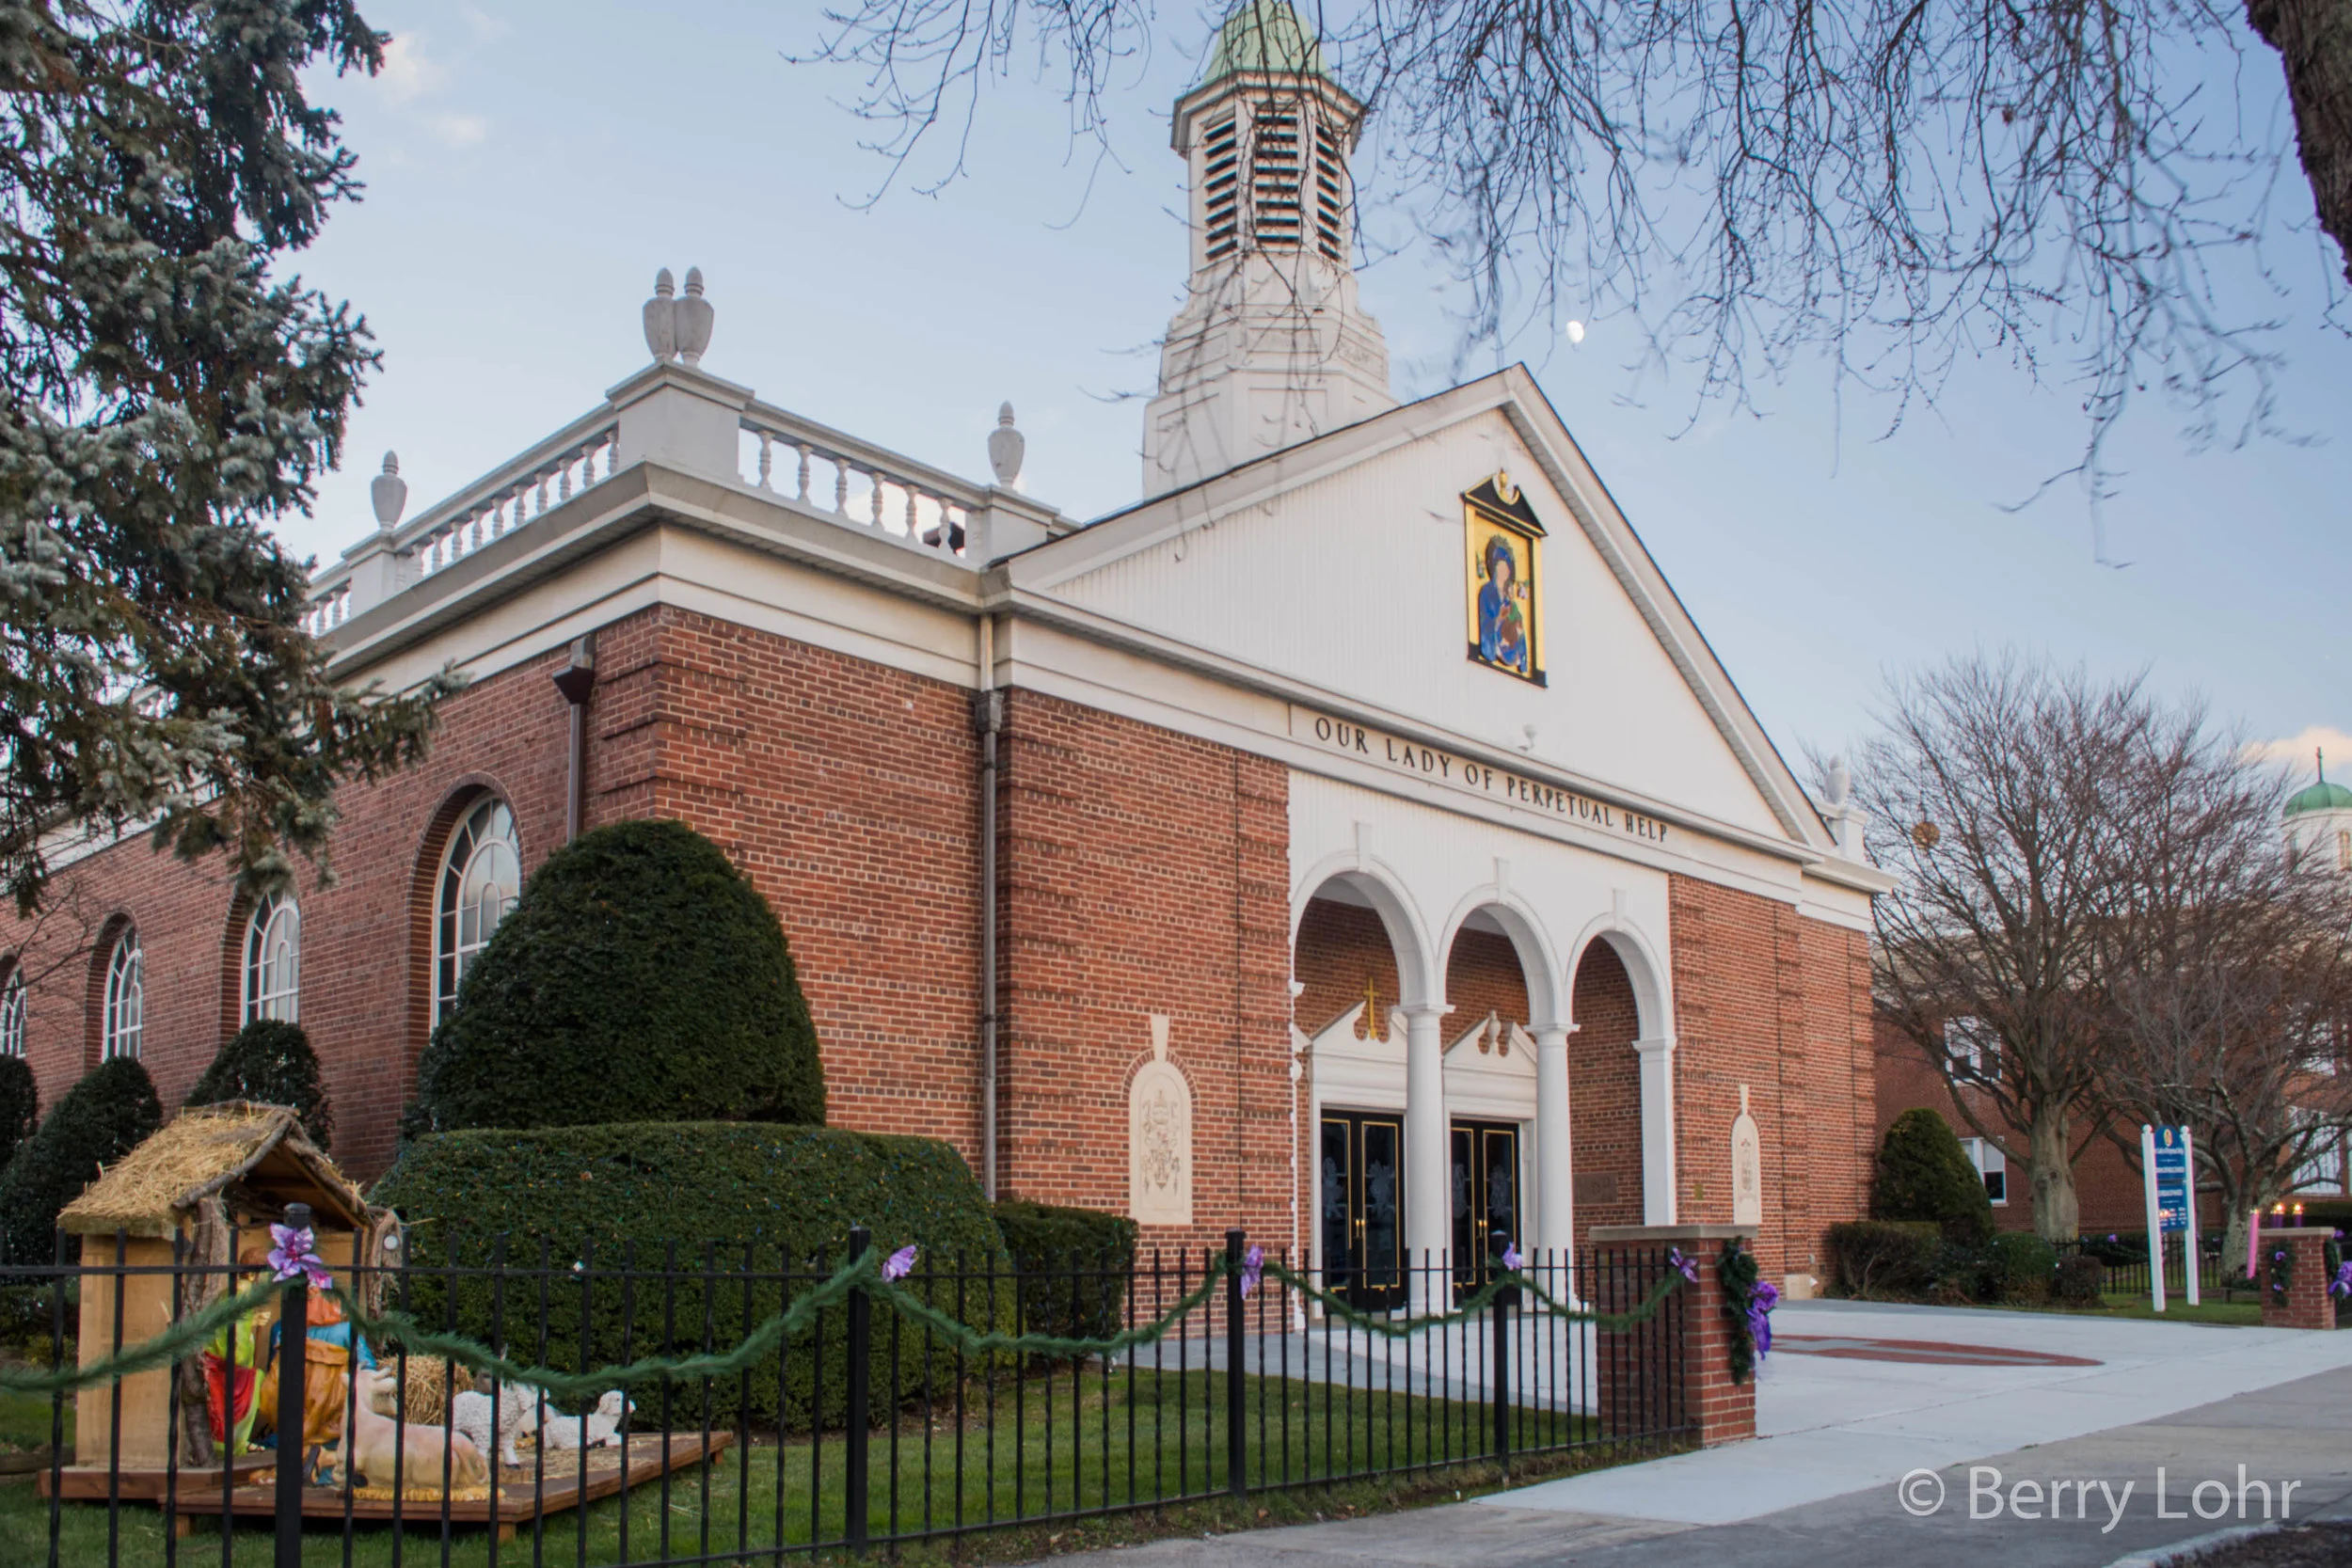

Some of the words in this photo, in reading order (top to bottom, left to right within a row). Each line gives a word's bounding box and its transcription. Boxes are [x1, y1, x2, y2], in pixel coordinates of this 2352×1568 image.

[1315, 718, 1369, 754] OUR
[1386, 737, 1451, 778] LADY
[1465, 764, 1493, 791] OF
[1507, 776, 1614, 828] PERPETUAL
[1625, 812, 1668, 843] HELP
